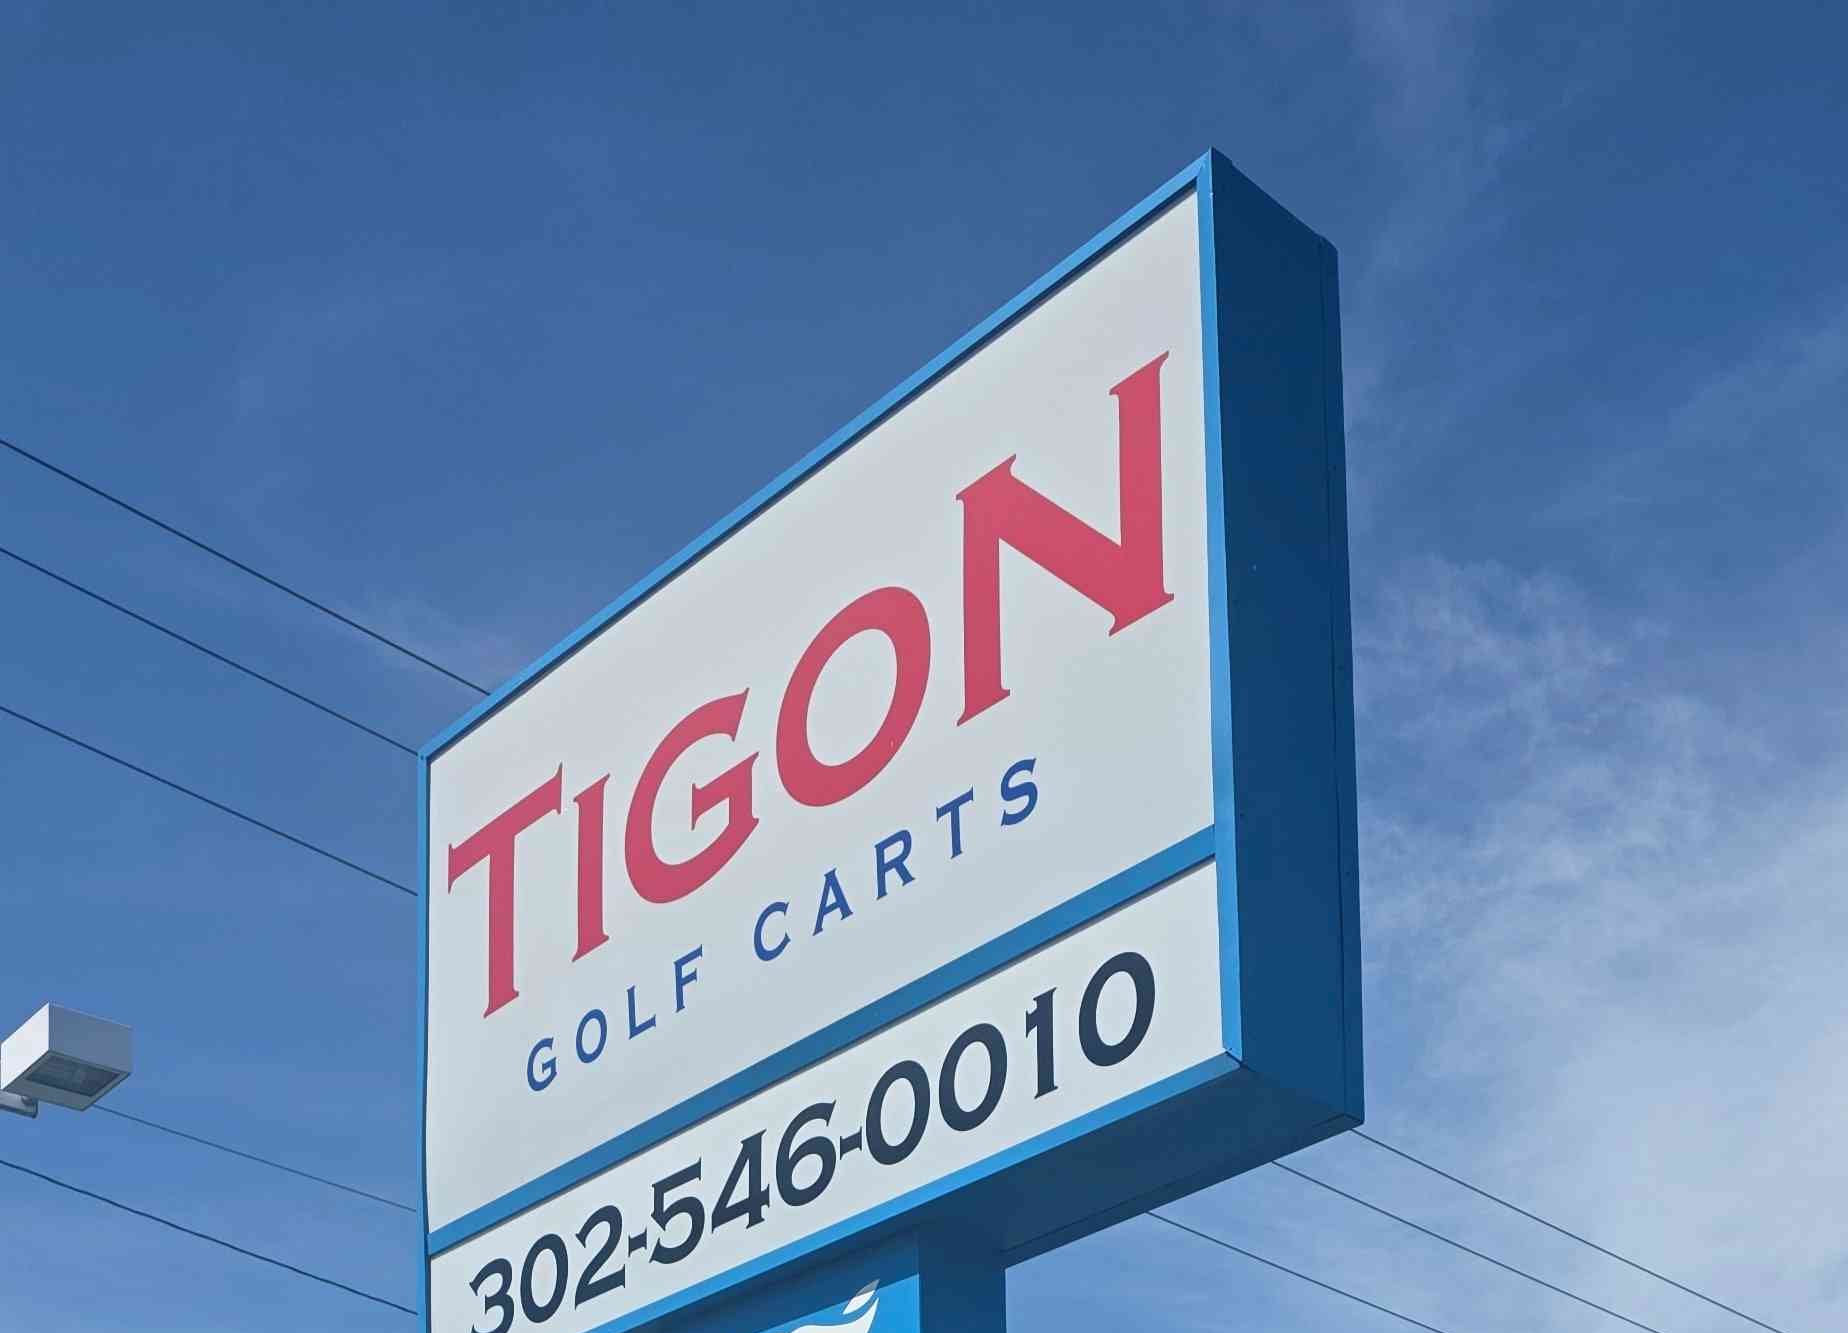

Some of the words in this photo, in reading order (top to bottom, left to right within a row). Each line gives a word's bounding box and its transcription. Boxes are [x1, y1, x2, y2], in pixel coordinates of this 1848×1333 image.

[447, 350, 1175, 1018] TIGON
[525, 946, 703, 1093] GOLF
[752, 757, 1040, 962] CARTS
